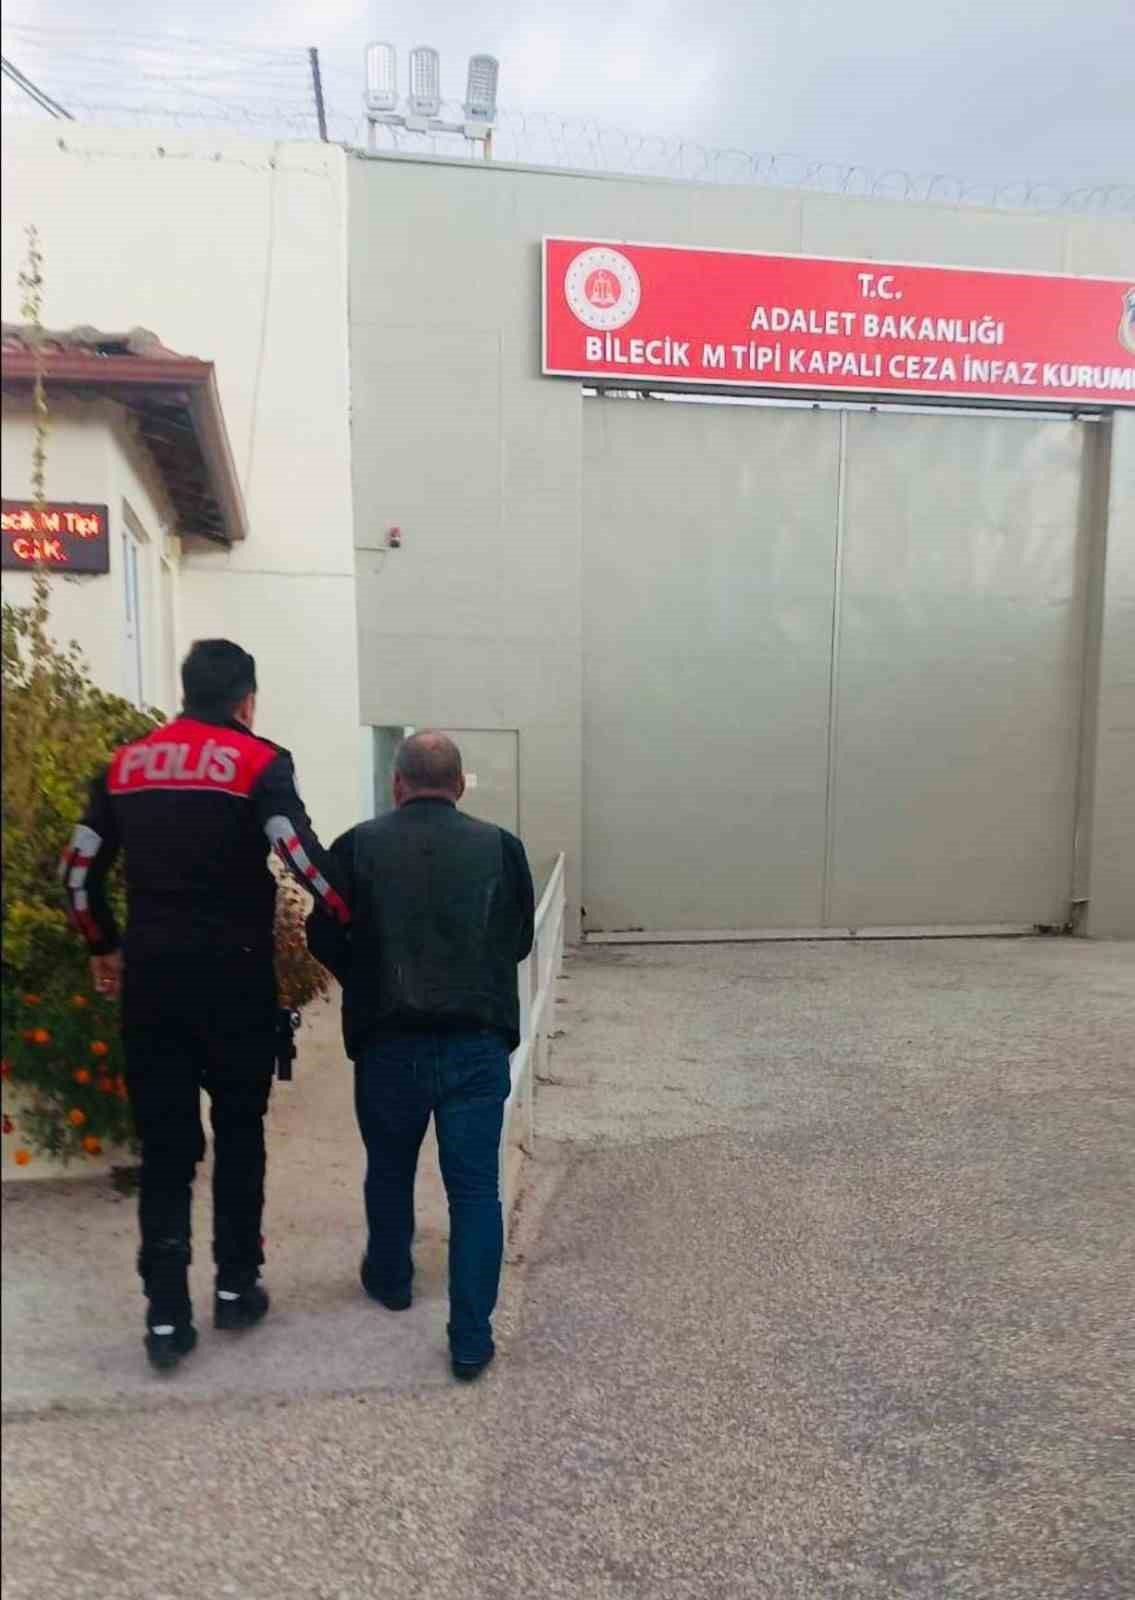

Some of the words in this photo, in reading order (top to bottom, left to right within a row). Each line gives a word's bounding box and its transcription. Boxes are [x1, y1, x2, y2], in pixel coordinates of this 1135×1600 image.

[858, 273, 902, 299] T.C.
[751, 306, 856, 336] ADALET
[863, 314, 1004, 344] BAKANLIĞI
[585, 332, 690, 367] BİLECİK
[702, 344, 725, 368] M
[731, 340, 782, 372] TİPİ
[789, 350, 881, 377] KAPALI
[888, 354, 956, 381] CEZA
[963, 353, 1039, 385] İNFAZ
[1042, 363, 1135, 390] KURUM
[118, 738, 241, 784] POLİS
